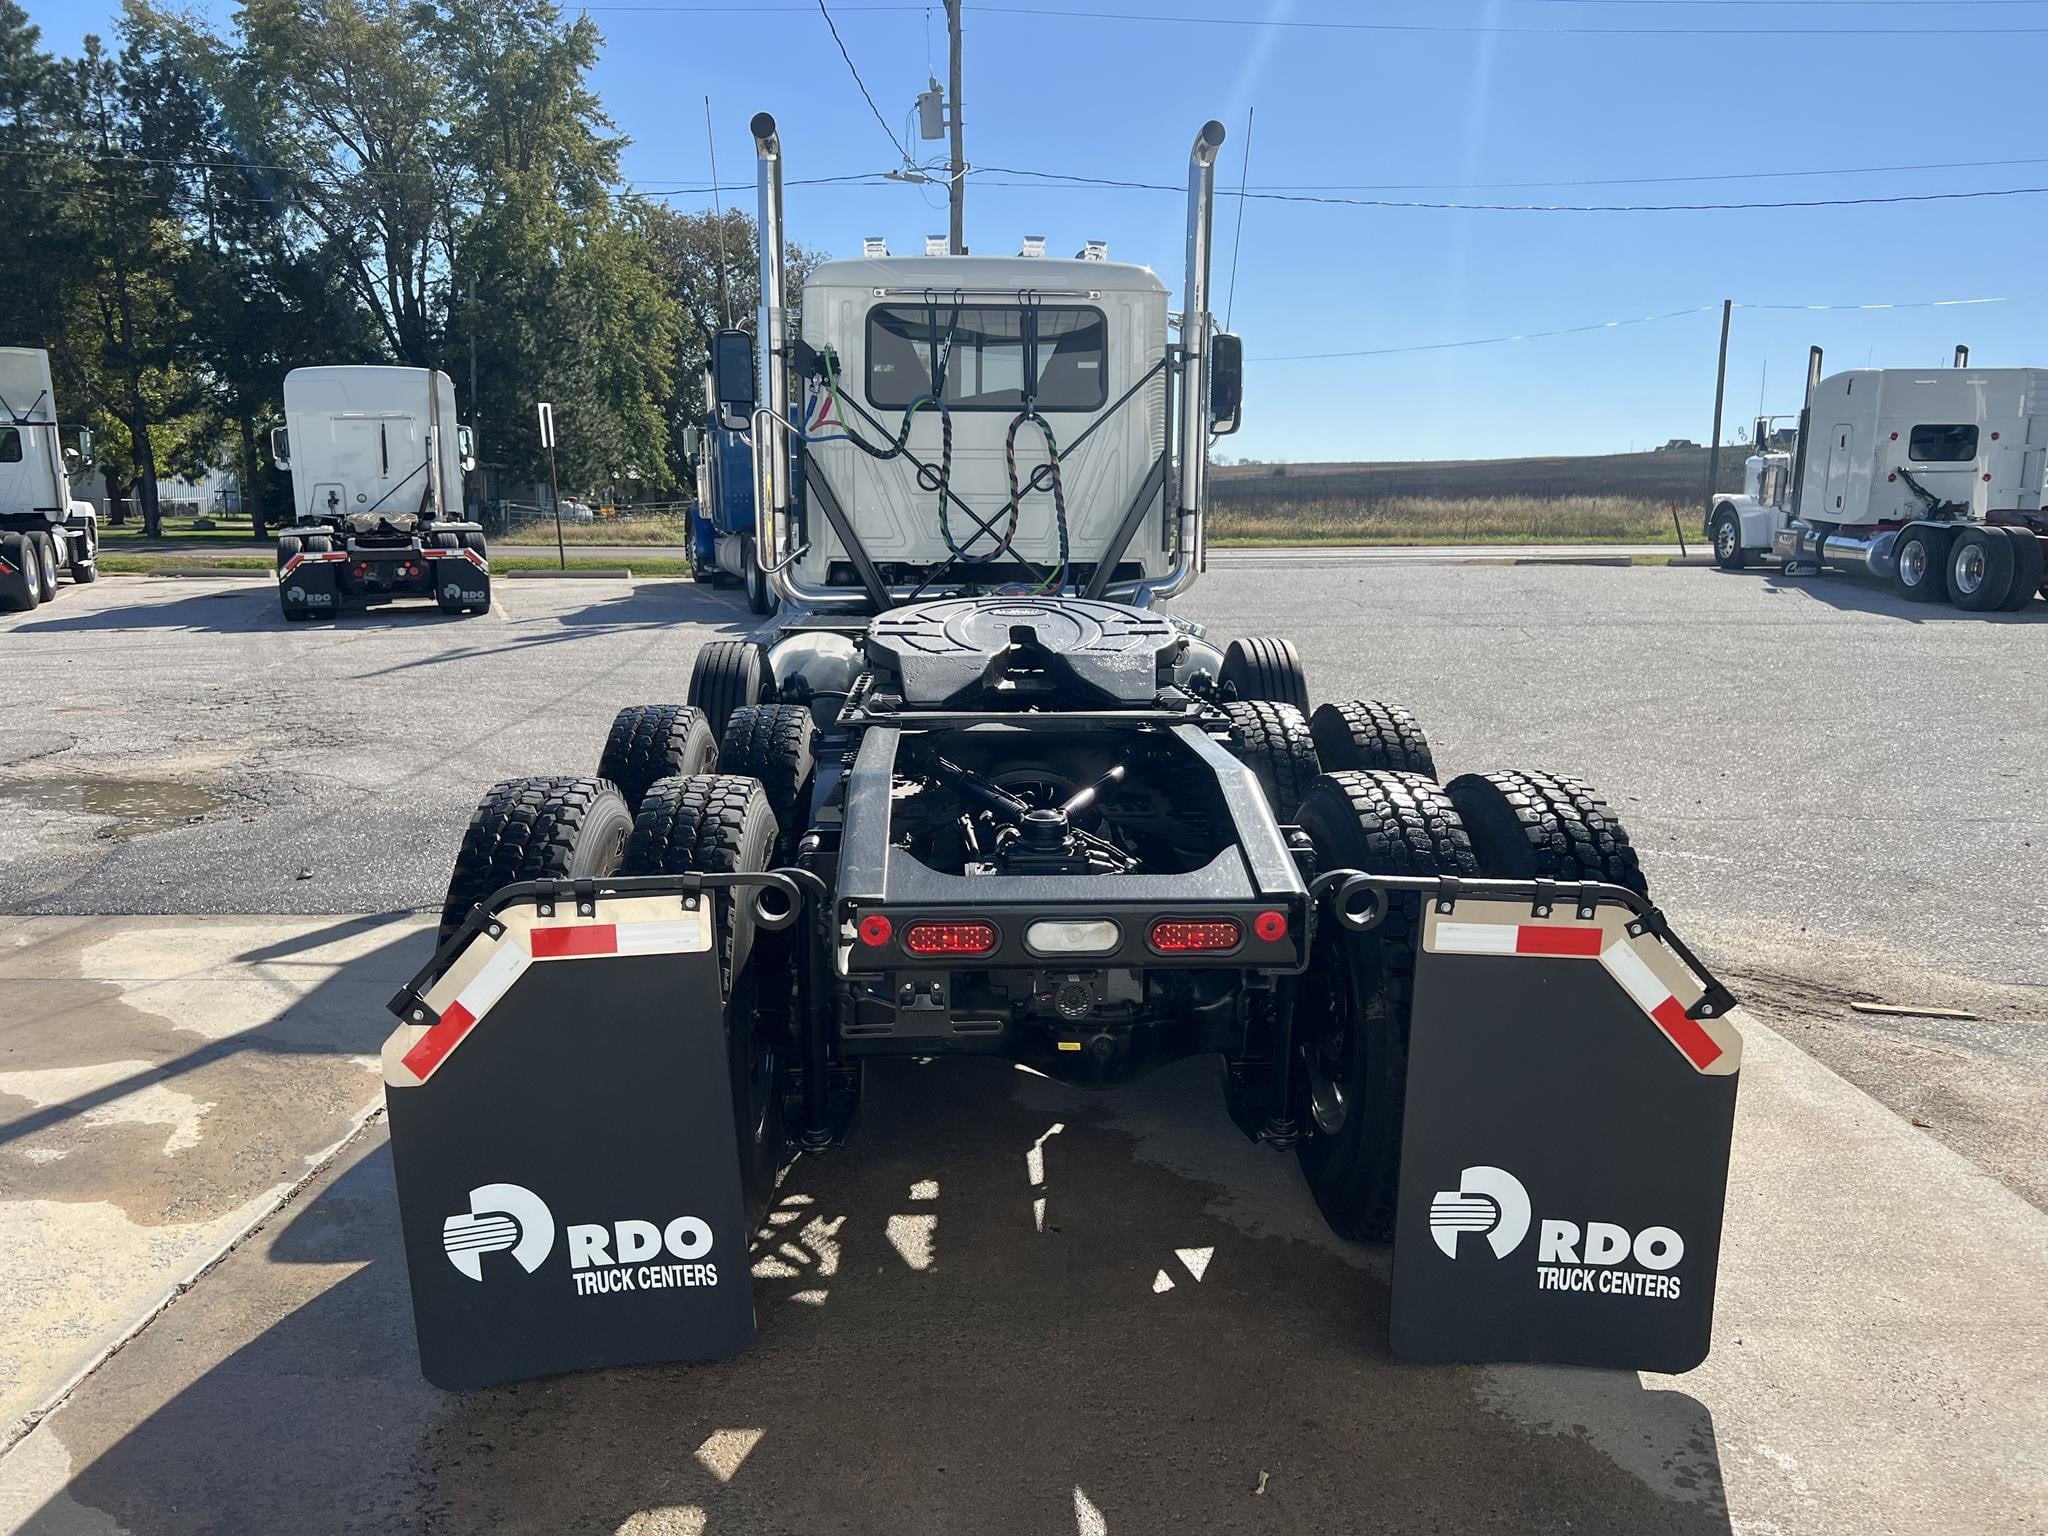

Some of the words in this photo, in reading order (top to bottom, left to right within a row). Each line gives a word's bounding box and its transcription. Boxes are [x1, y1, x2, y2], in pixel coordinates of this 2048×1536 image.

[307, 593, 331, 601] RDO
[462, 591, 485, 599] RDO
[566, 1216, 714, 1269] RDO
[1538, 1219, 1685, 1271] RDO
[572, 1267, 636, 1296] TRUCK
[637, 1263, 718, 1289] CENTERS
[1537, 1266, 1597, 1292] TRUCK
[1599, 1269, 1681, 1300] CENTERS
